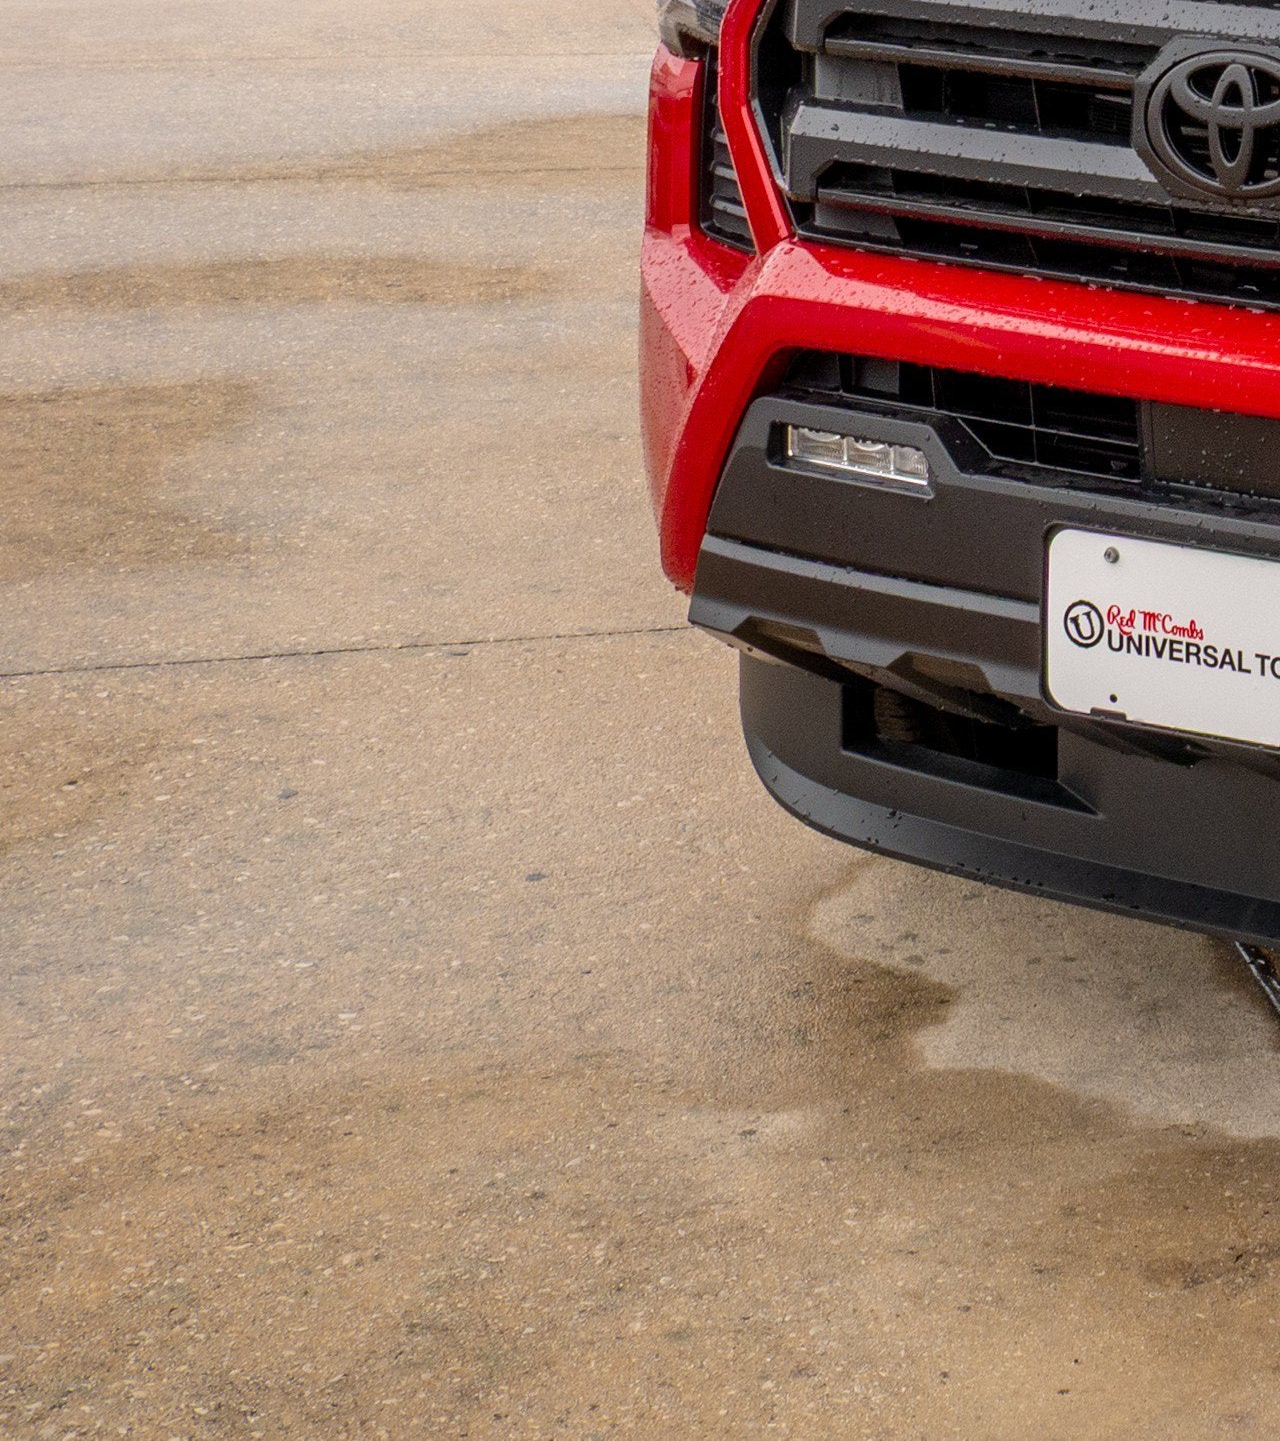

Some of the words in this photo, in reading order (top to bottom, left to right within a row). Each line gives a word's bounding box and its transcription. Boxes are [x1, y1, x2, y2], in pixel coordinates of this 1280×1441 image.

[1107, 604, 1136, 637] Red
[1138, 609, 1204, 641] McCombs
[1107, 630, 1252, 674] UNIVERSAL
